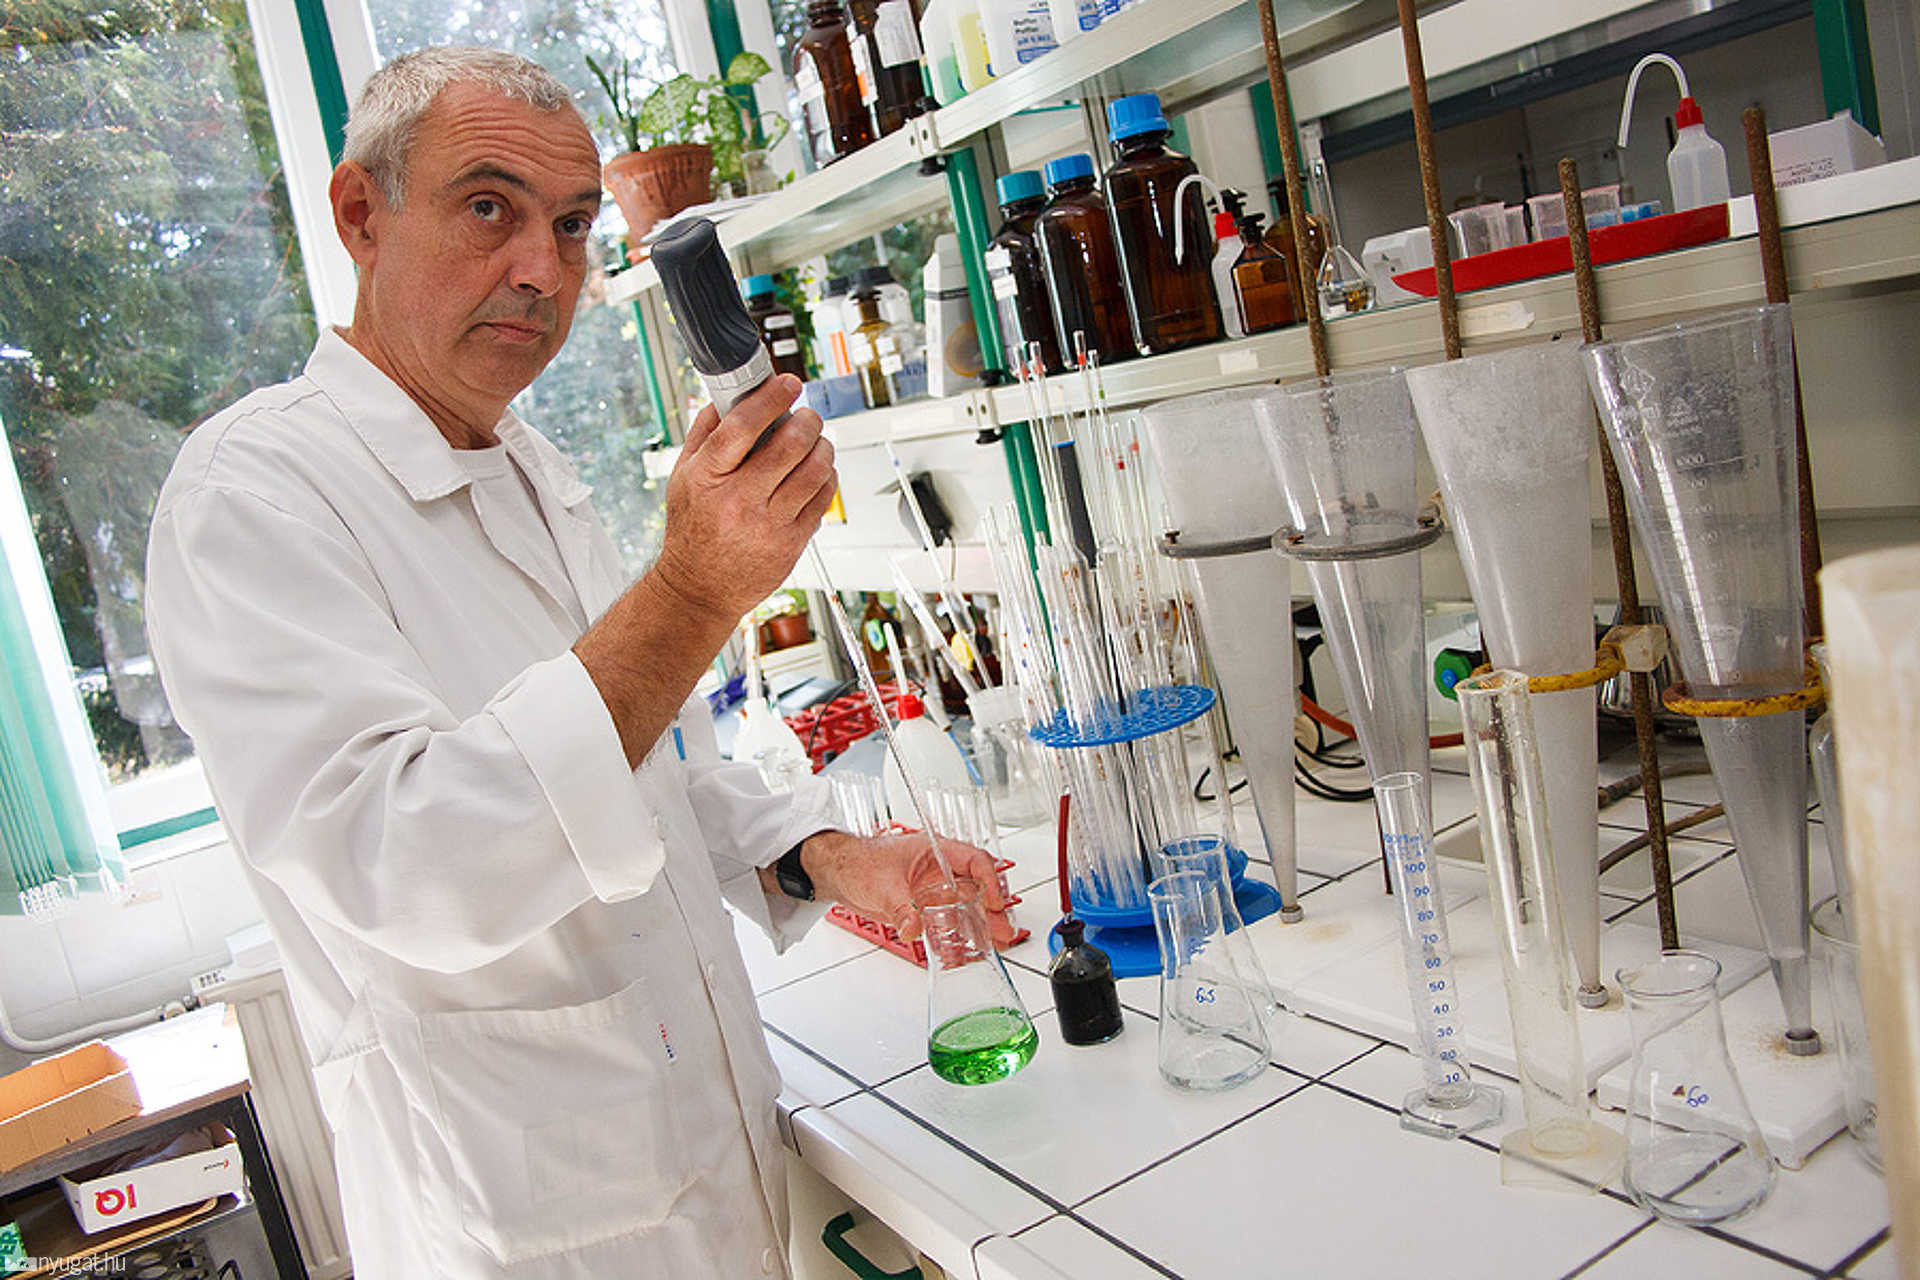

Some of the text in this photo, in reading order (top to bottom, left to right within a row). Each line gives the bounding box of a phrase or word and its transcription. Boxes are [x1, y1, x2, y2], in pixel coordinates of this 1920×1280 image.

[1404, 861, 1426, 874] 100
[1413, 885, 1430, 897] 90
[1417, 910, 1434, 922] 80
[1421, 934, 1439, 945] 70
[1425, 957, 1441, 969] 60
[1429, 980, 1445, 992] 50
[1433, 1003, 1449, 1015] 40
[1437, 1026, 1453, 1038] 30
[1440, 1049, 1457, 1061] 20
[1445, 1072, 1460, 1084] 10
